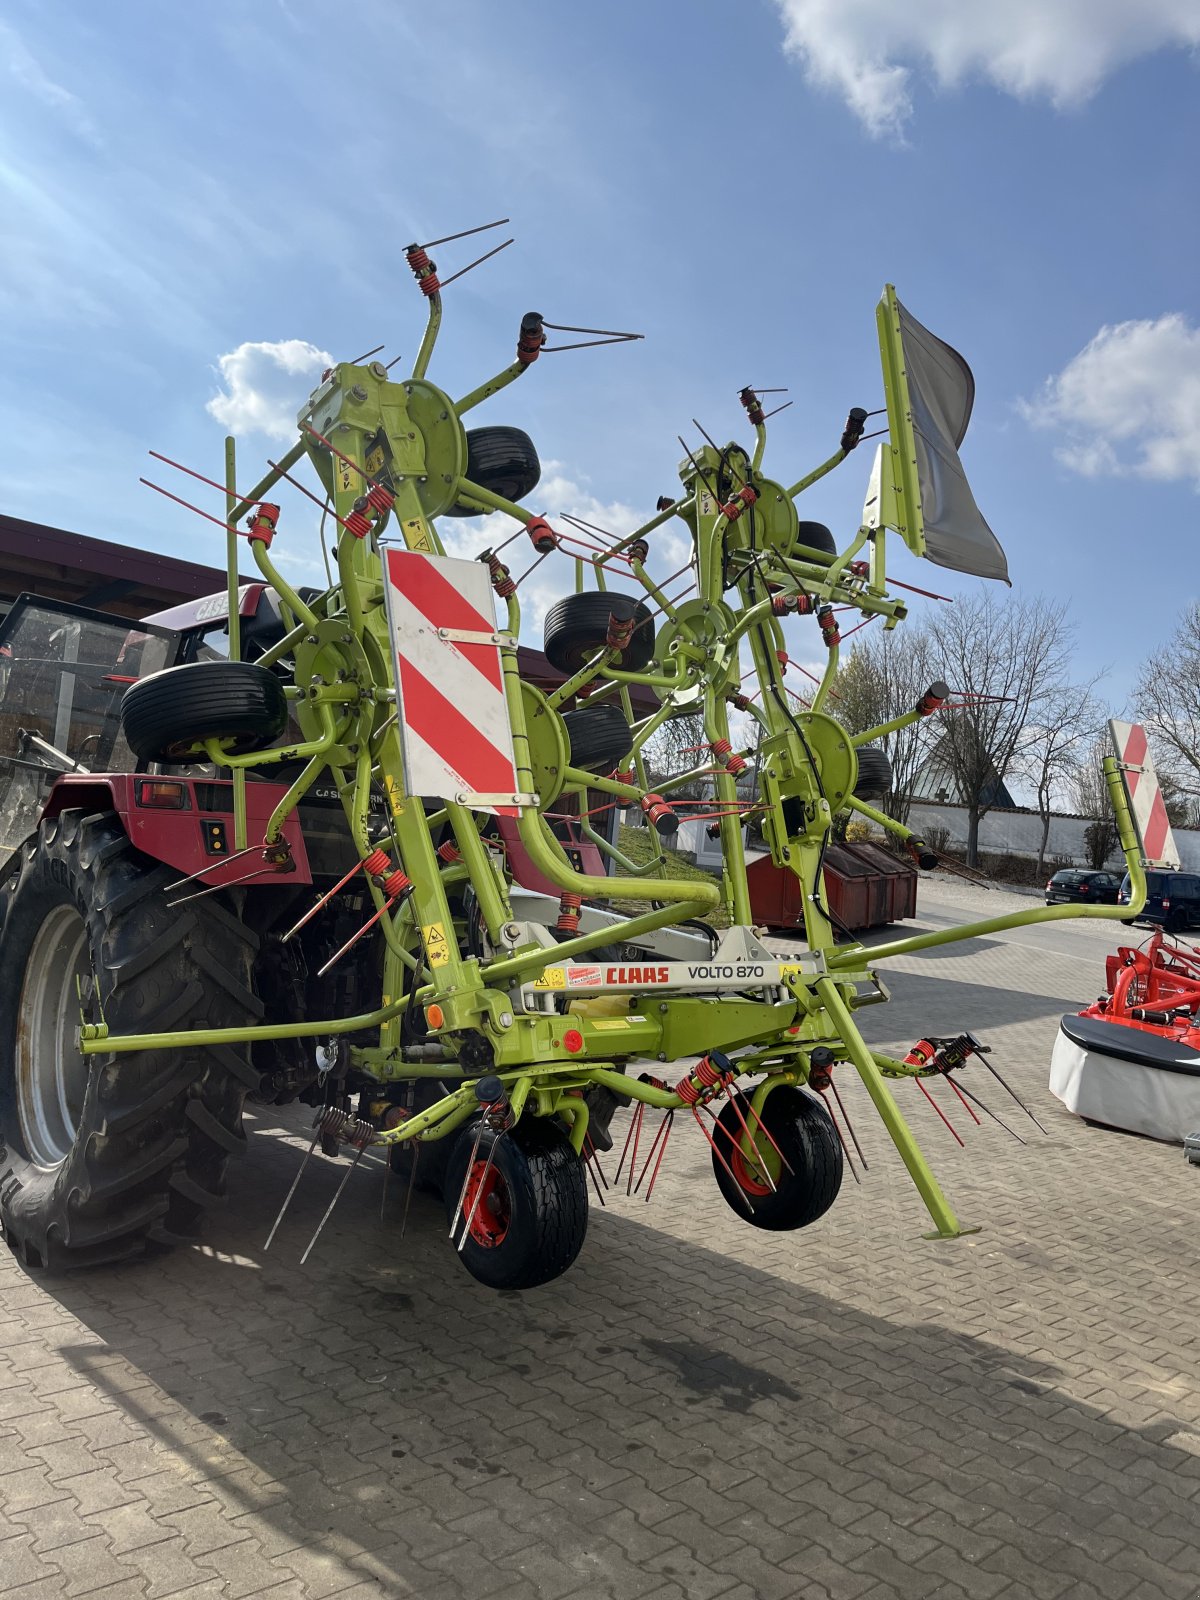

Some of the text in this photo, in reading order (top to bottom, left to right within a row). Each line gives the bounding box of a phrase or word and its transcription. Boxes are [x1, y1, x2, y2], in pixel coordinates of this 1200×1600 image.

[606, 967, 669, 985] CLAAS
[688, 966, 733, 979] VOLTO
[736, 965, 764, 978] 870
